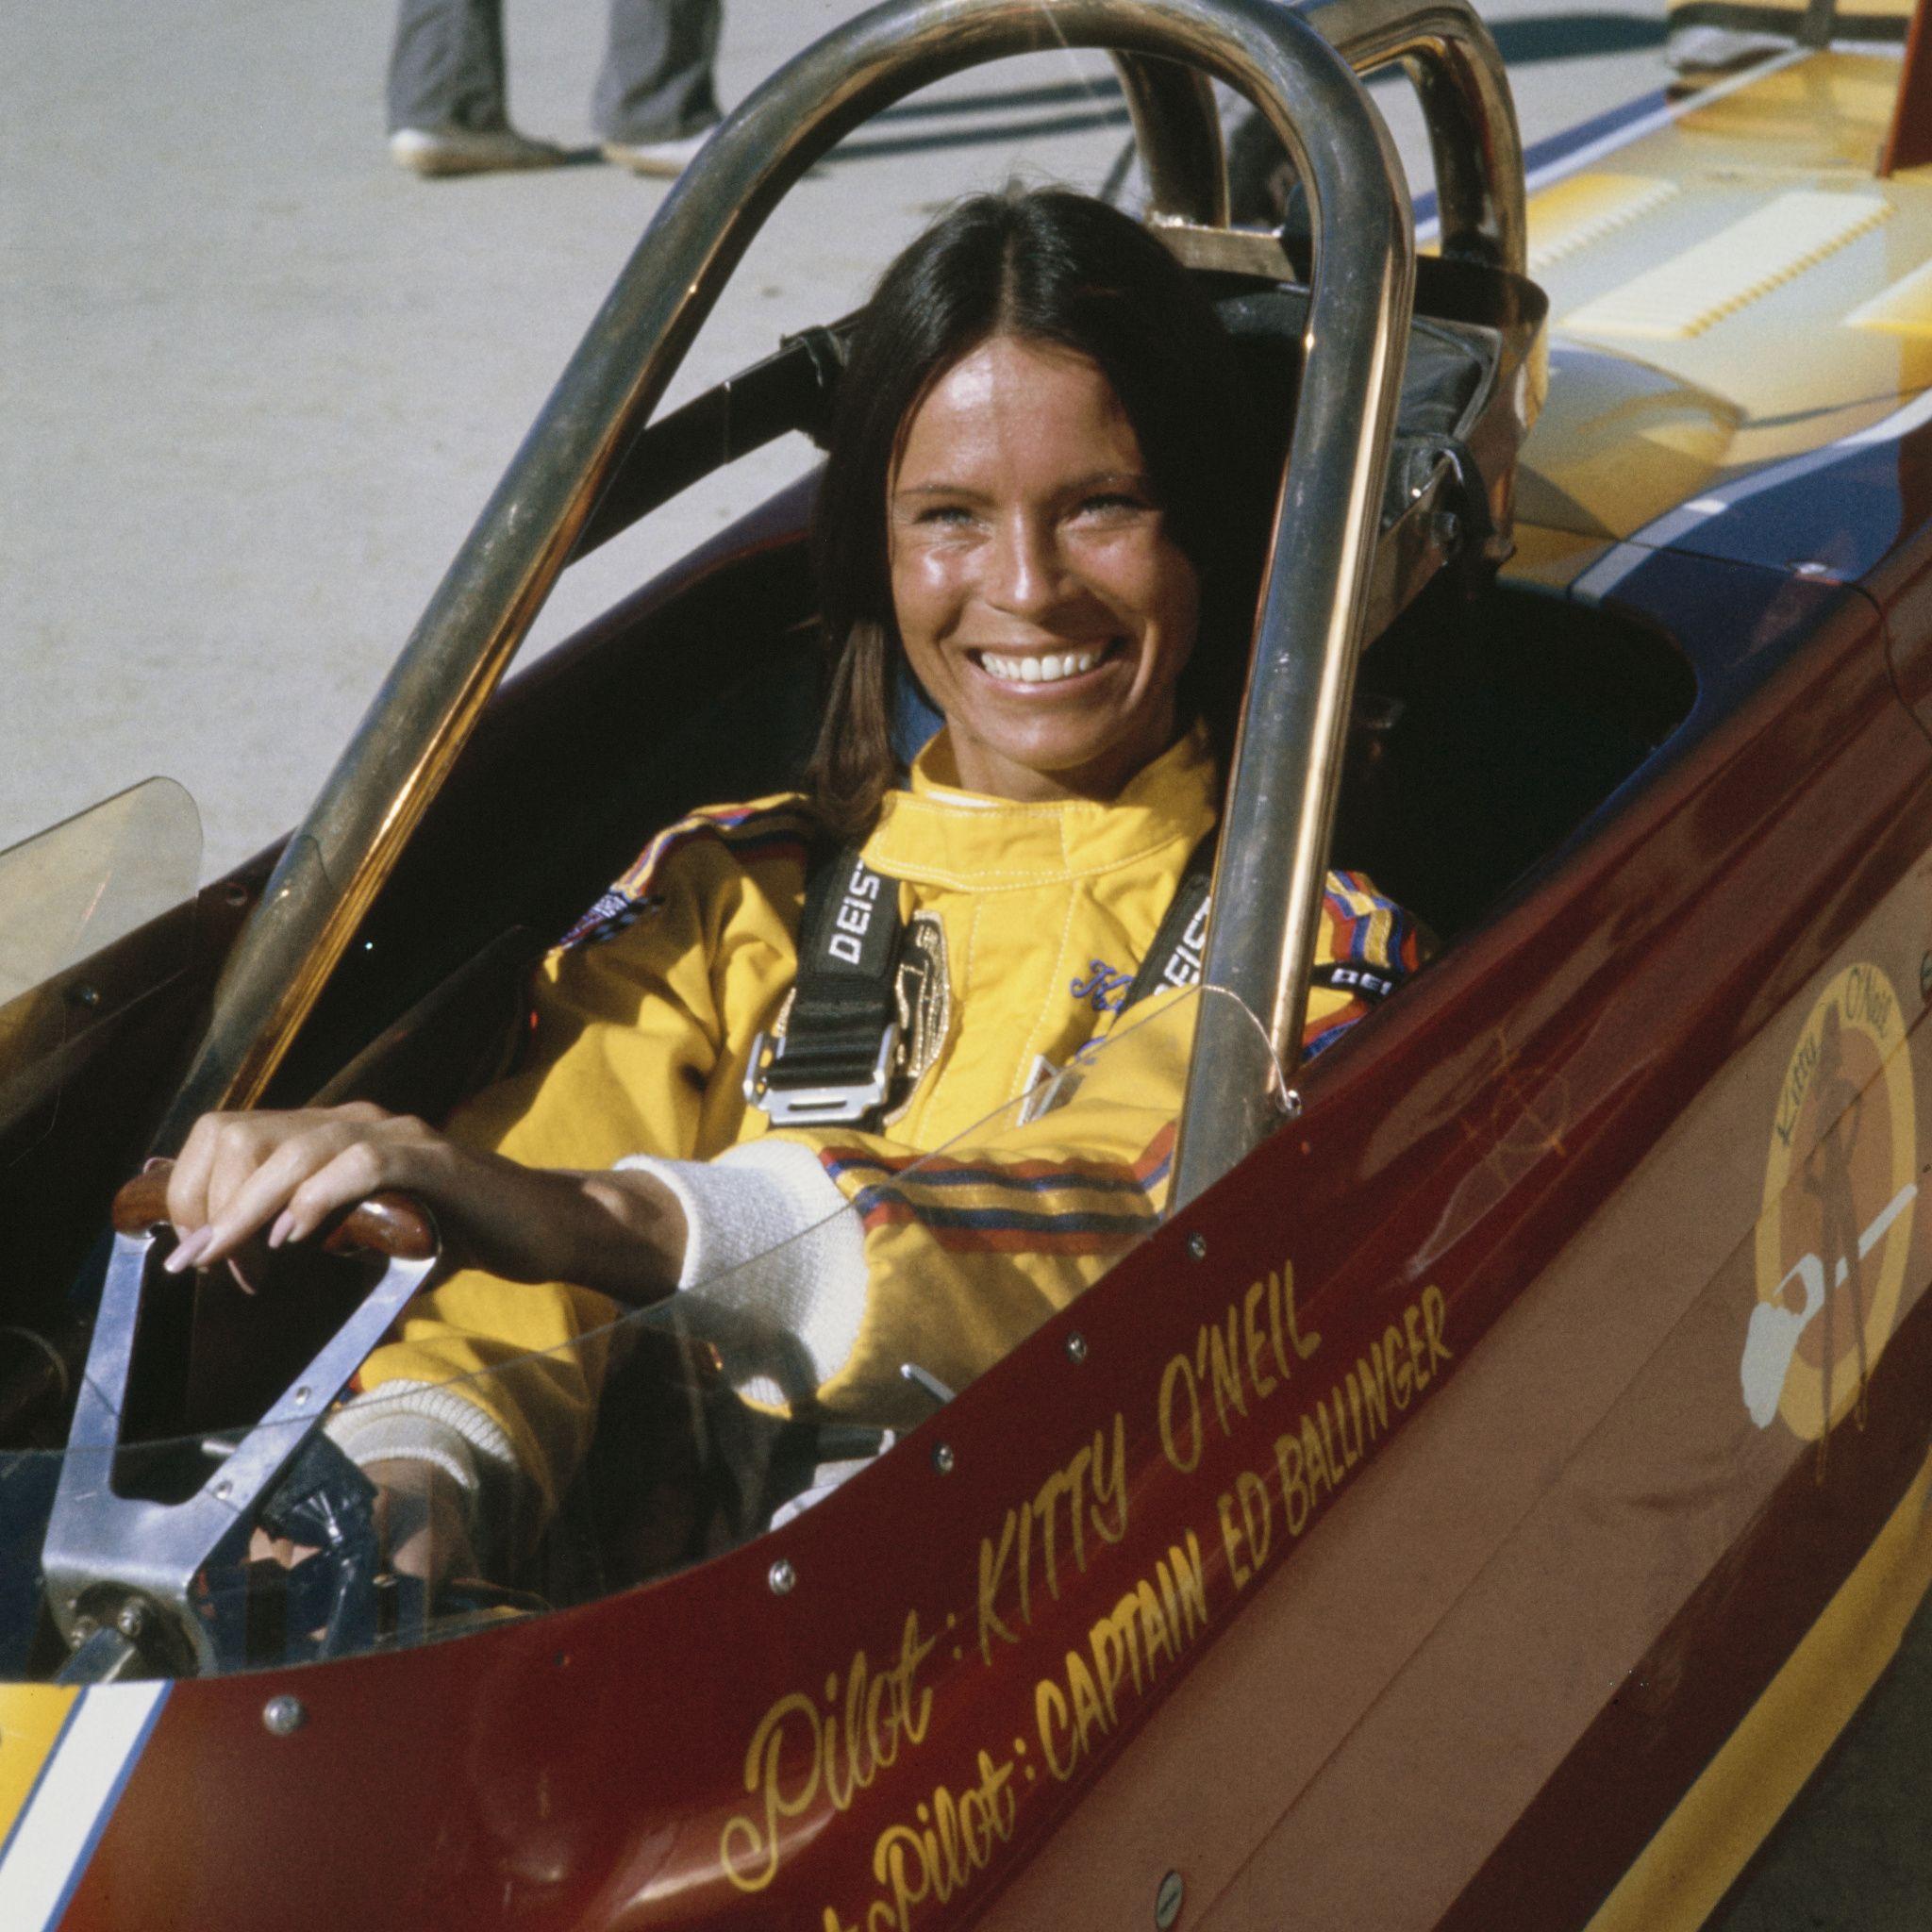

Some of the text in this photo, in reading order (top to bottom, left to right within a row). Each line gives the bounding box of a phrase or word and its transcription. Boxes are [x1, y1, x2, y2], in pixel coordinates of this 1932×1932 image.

[828, 858, 880, 964] DEIS
[977, 1412, 1128, 1665] KITTY
[1158, 1259, 1321, 1473] O'NEIL
[1035, 1529, 1208, 1781] CAPTAIN
[1217, 1471, 1272, 1591] ED
[1274, 1284, 1454, 1537] BALLINGER
